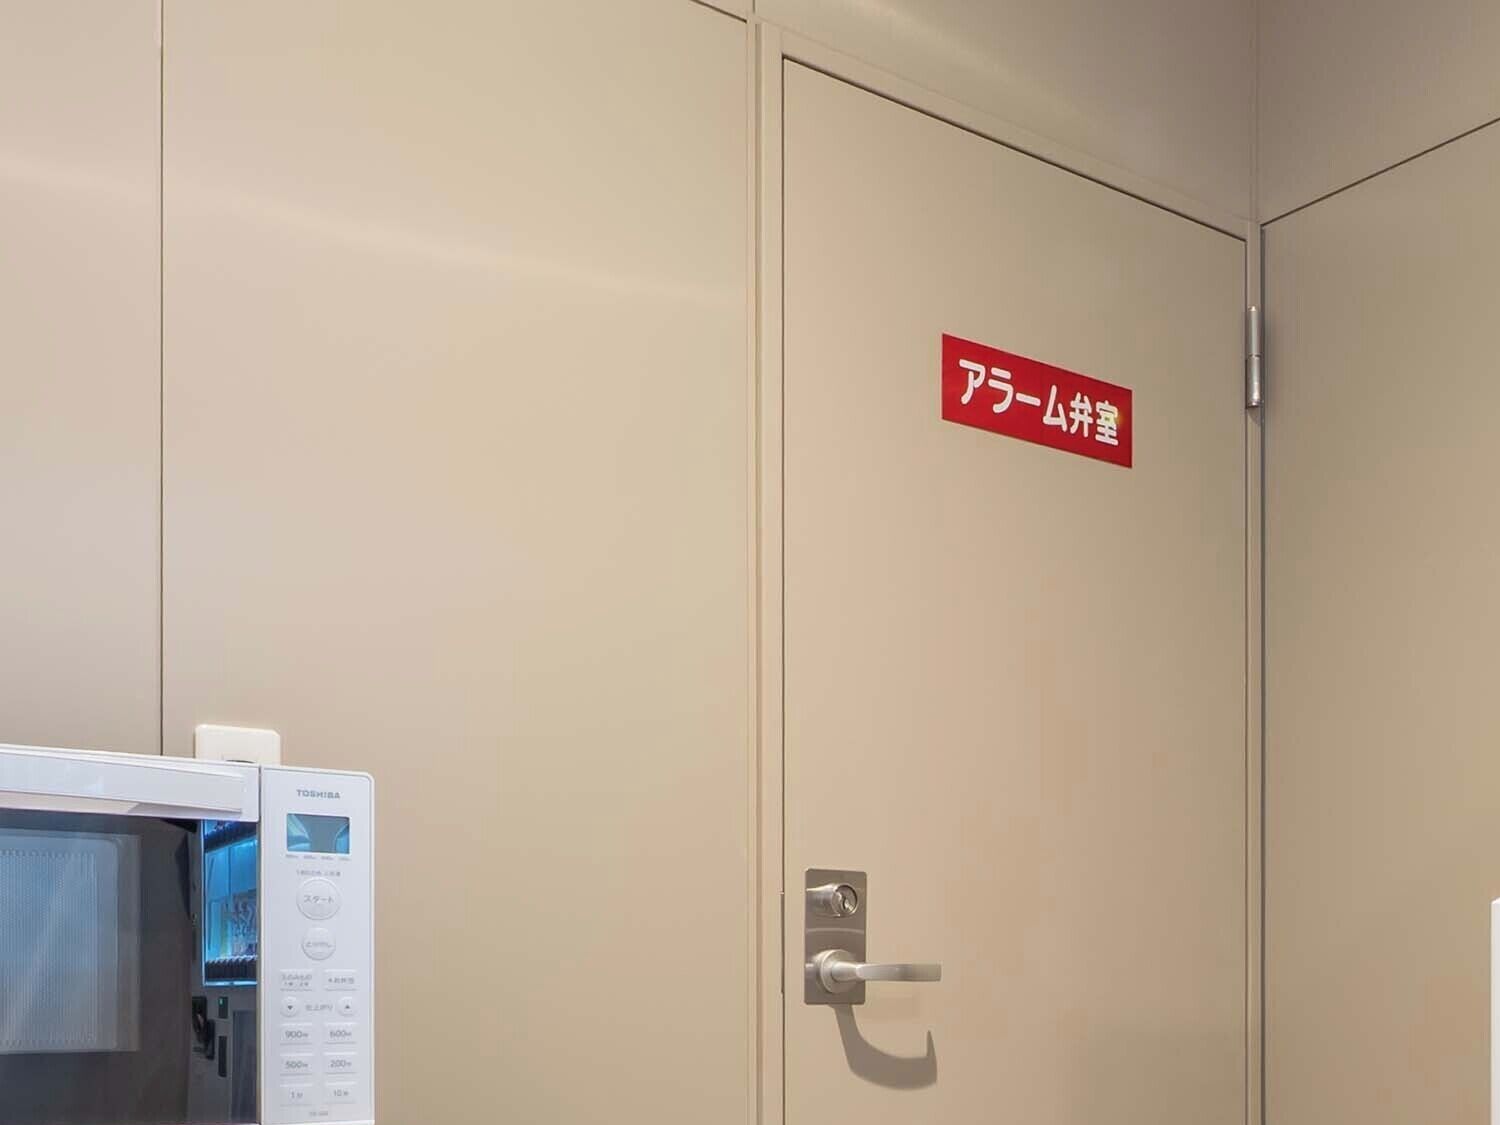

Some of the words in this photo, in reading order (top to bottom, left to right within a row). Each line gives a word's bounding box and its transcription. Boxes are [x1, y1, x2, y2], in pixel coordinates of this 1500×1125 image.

[959, 358, 1119, 446] アラーム弁室
[296, 789, 341, 799] TOSHIBA
